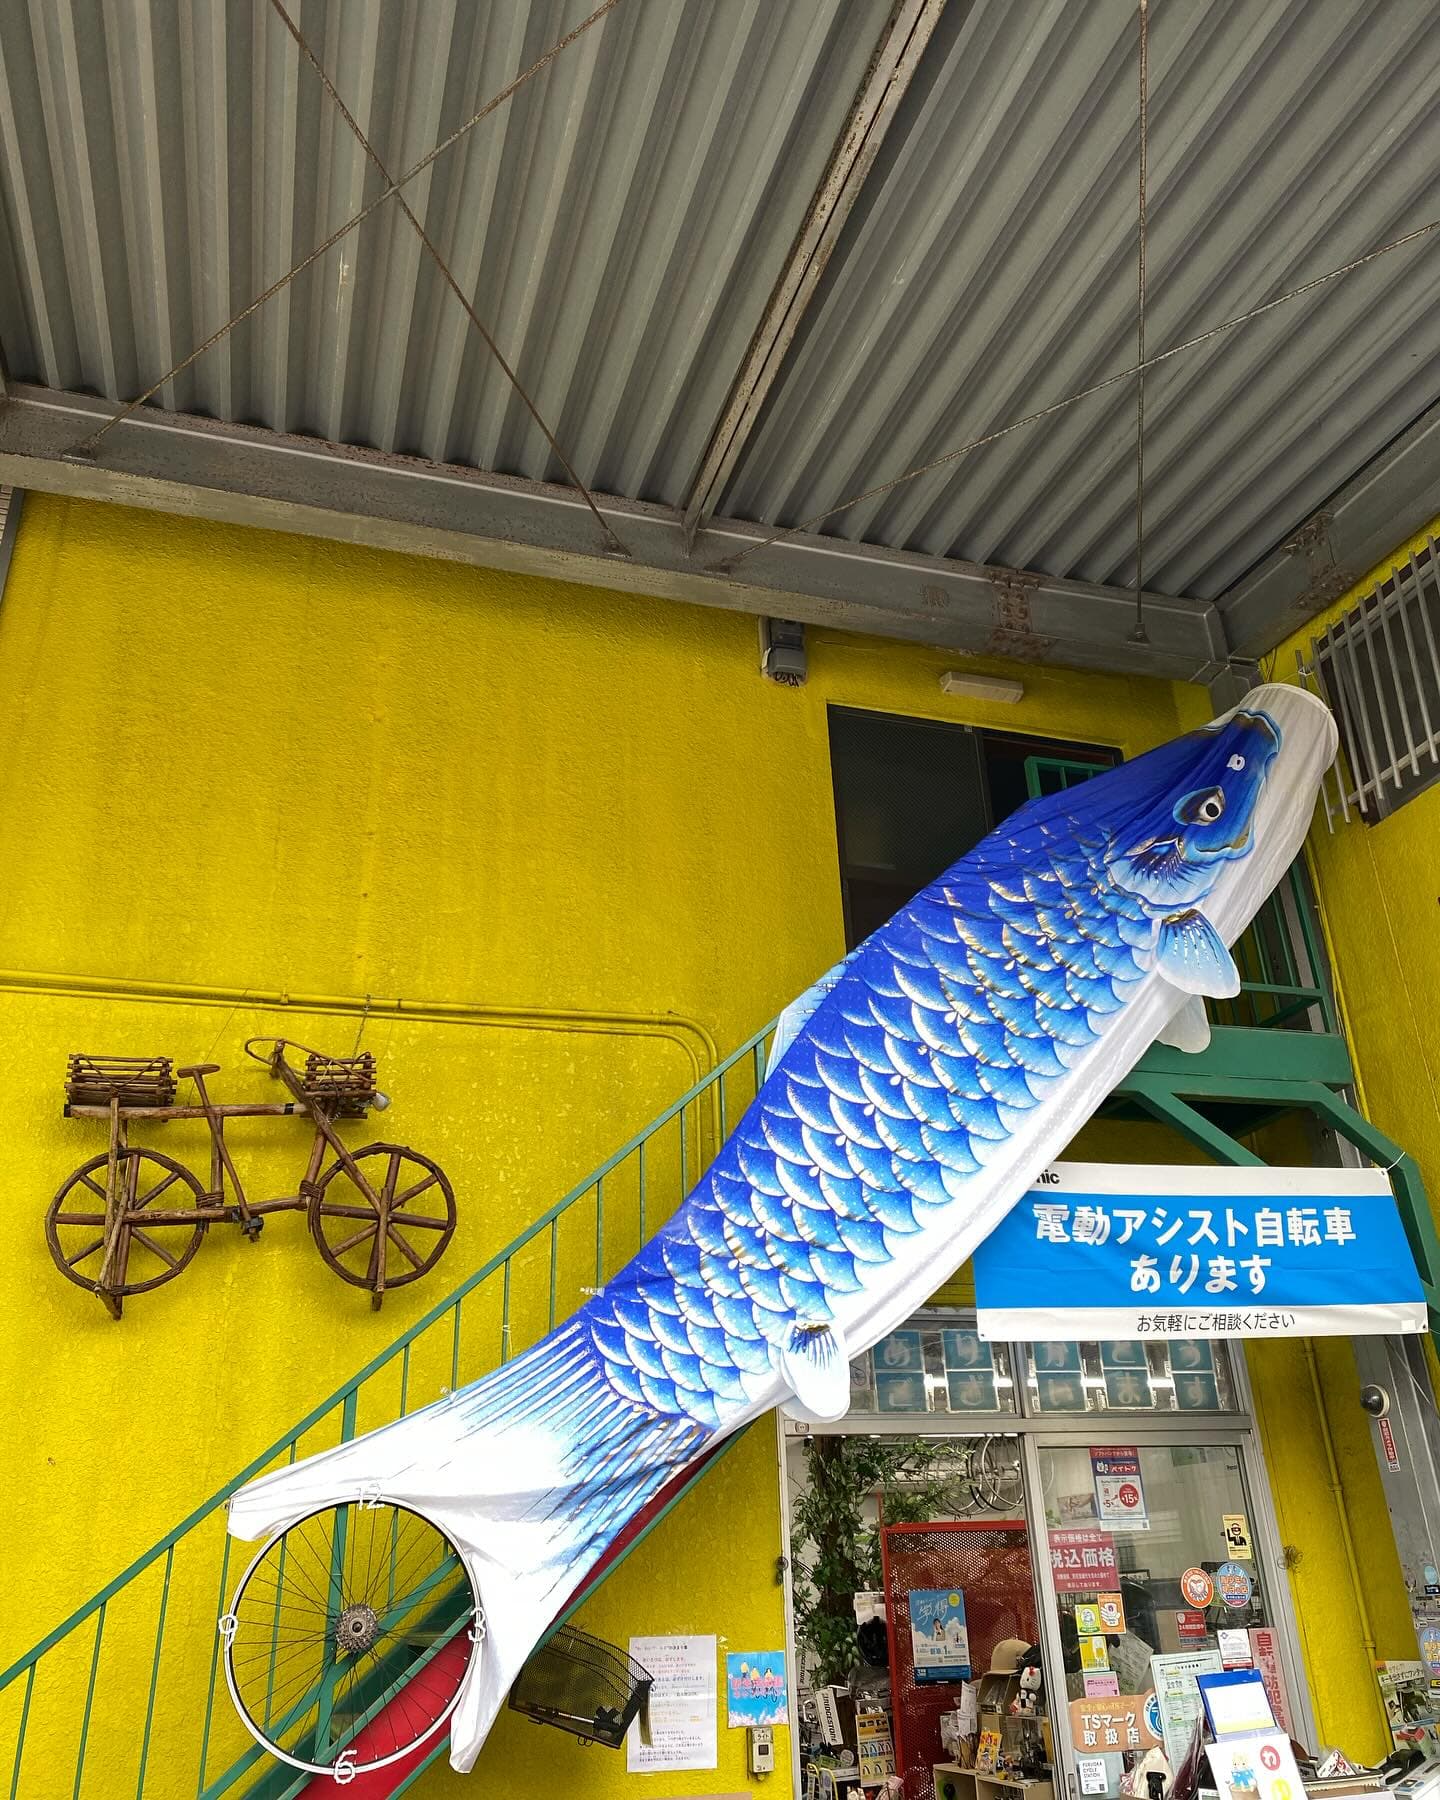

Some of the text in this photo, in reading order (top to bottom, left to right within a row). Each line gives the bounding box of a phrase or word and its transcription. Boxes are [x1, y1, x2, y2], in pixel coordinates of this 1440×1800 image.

[1032, 1203, 1357, 1247] 電動アシスト自転車
[1130, 1254, 1272, 1295] あります
[1137, 1311, 1295, 1333] お気軽にご相談ください
[357, 1483, 386, 1511] 12
[1050, 1547, 1115, 1569] 税込価格
[218, 1613, 239, 1652] 9
[468, 1607, 486, 1643] 3
[1081, 1711, 1136, 1730] TSマーク
